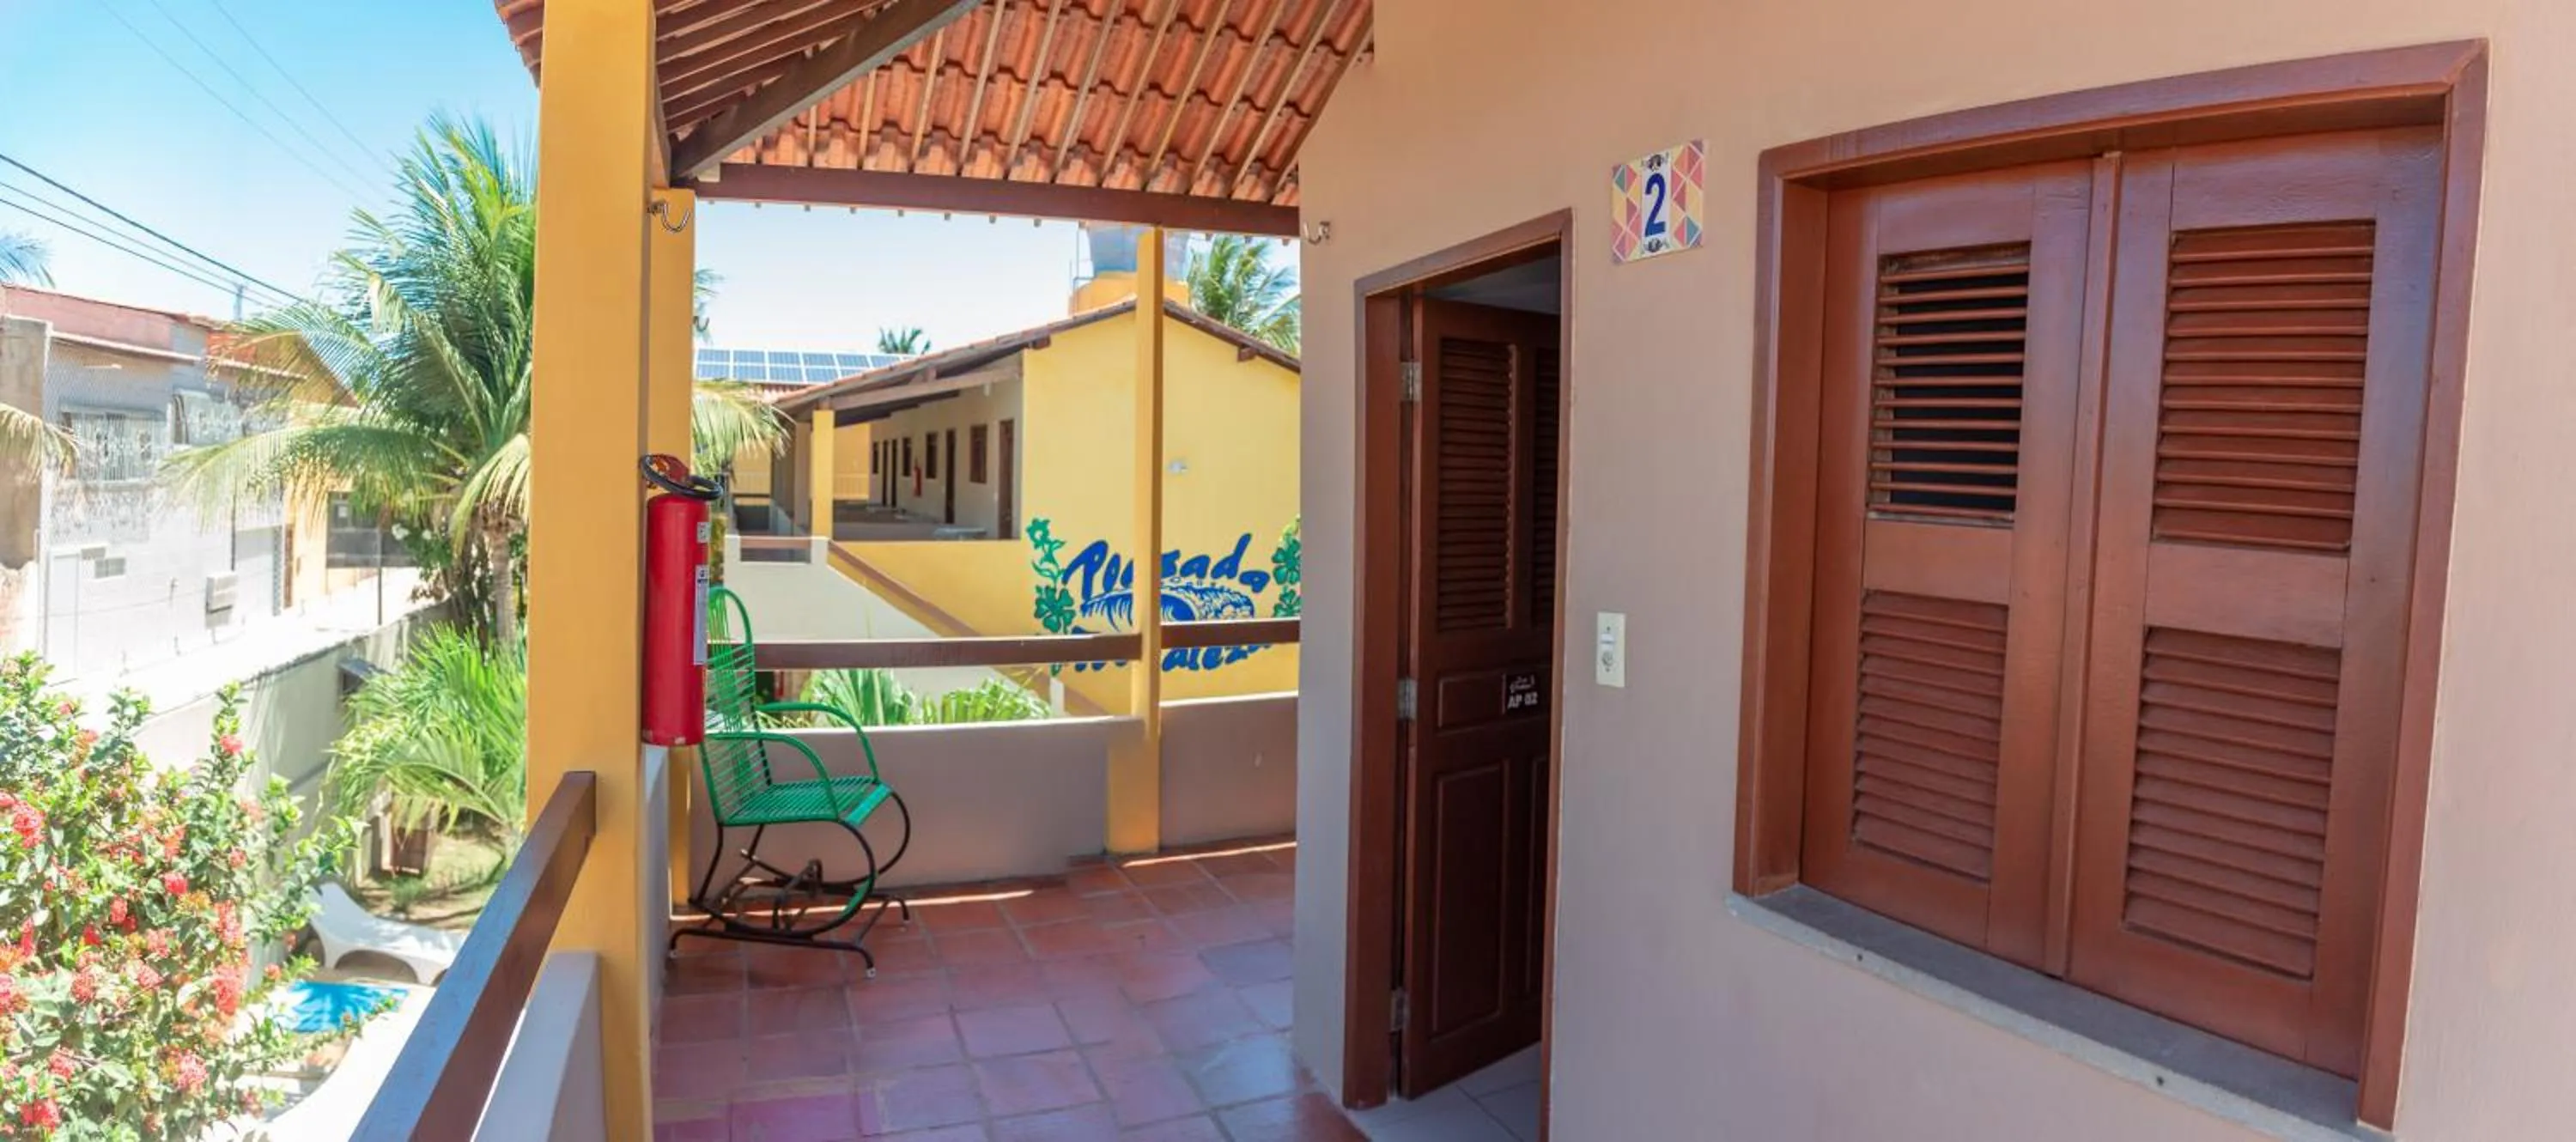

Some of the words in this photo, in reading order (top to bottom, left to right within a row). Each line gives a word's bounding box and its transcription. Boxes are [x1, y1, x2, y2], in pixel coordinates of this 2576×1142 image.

[1644, 173, 1667, 237] 2
[1507, 694, 1522, 709] AP
[1524, 690, 1538, 705] 02
